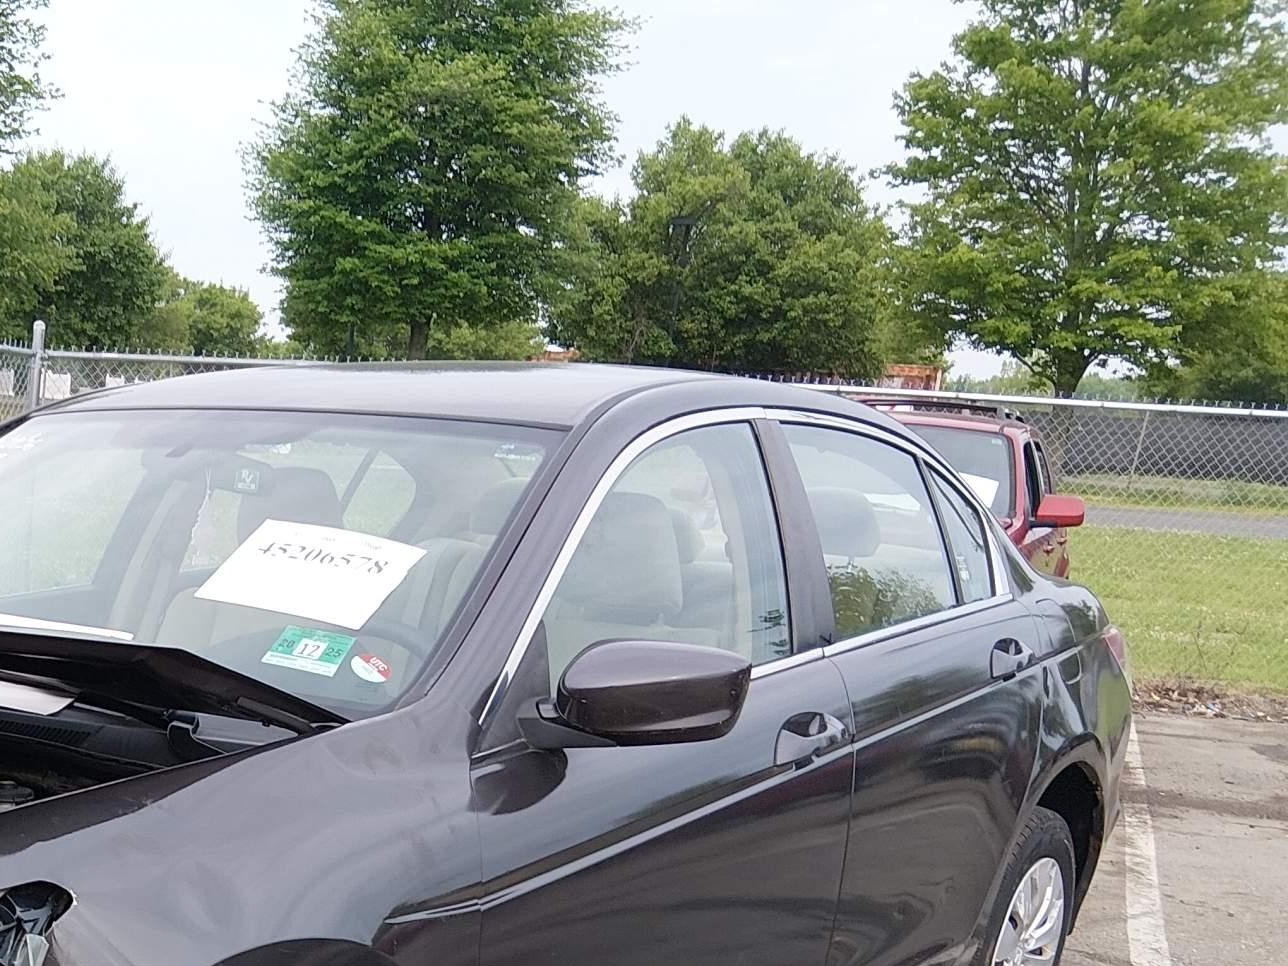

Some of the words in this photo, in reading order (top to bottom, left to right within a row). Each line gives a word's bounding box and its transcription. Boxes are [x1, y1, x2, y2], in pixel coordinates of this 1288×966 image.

[258, 541, 390, 575] 45206578
[297, 643, 321, 657] 12
[325, 647, 344, 658] 25
[369, 656, 388, 672] UTC
